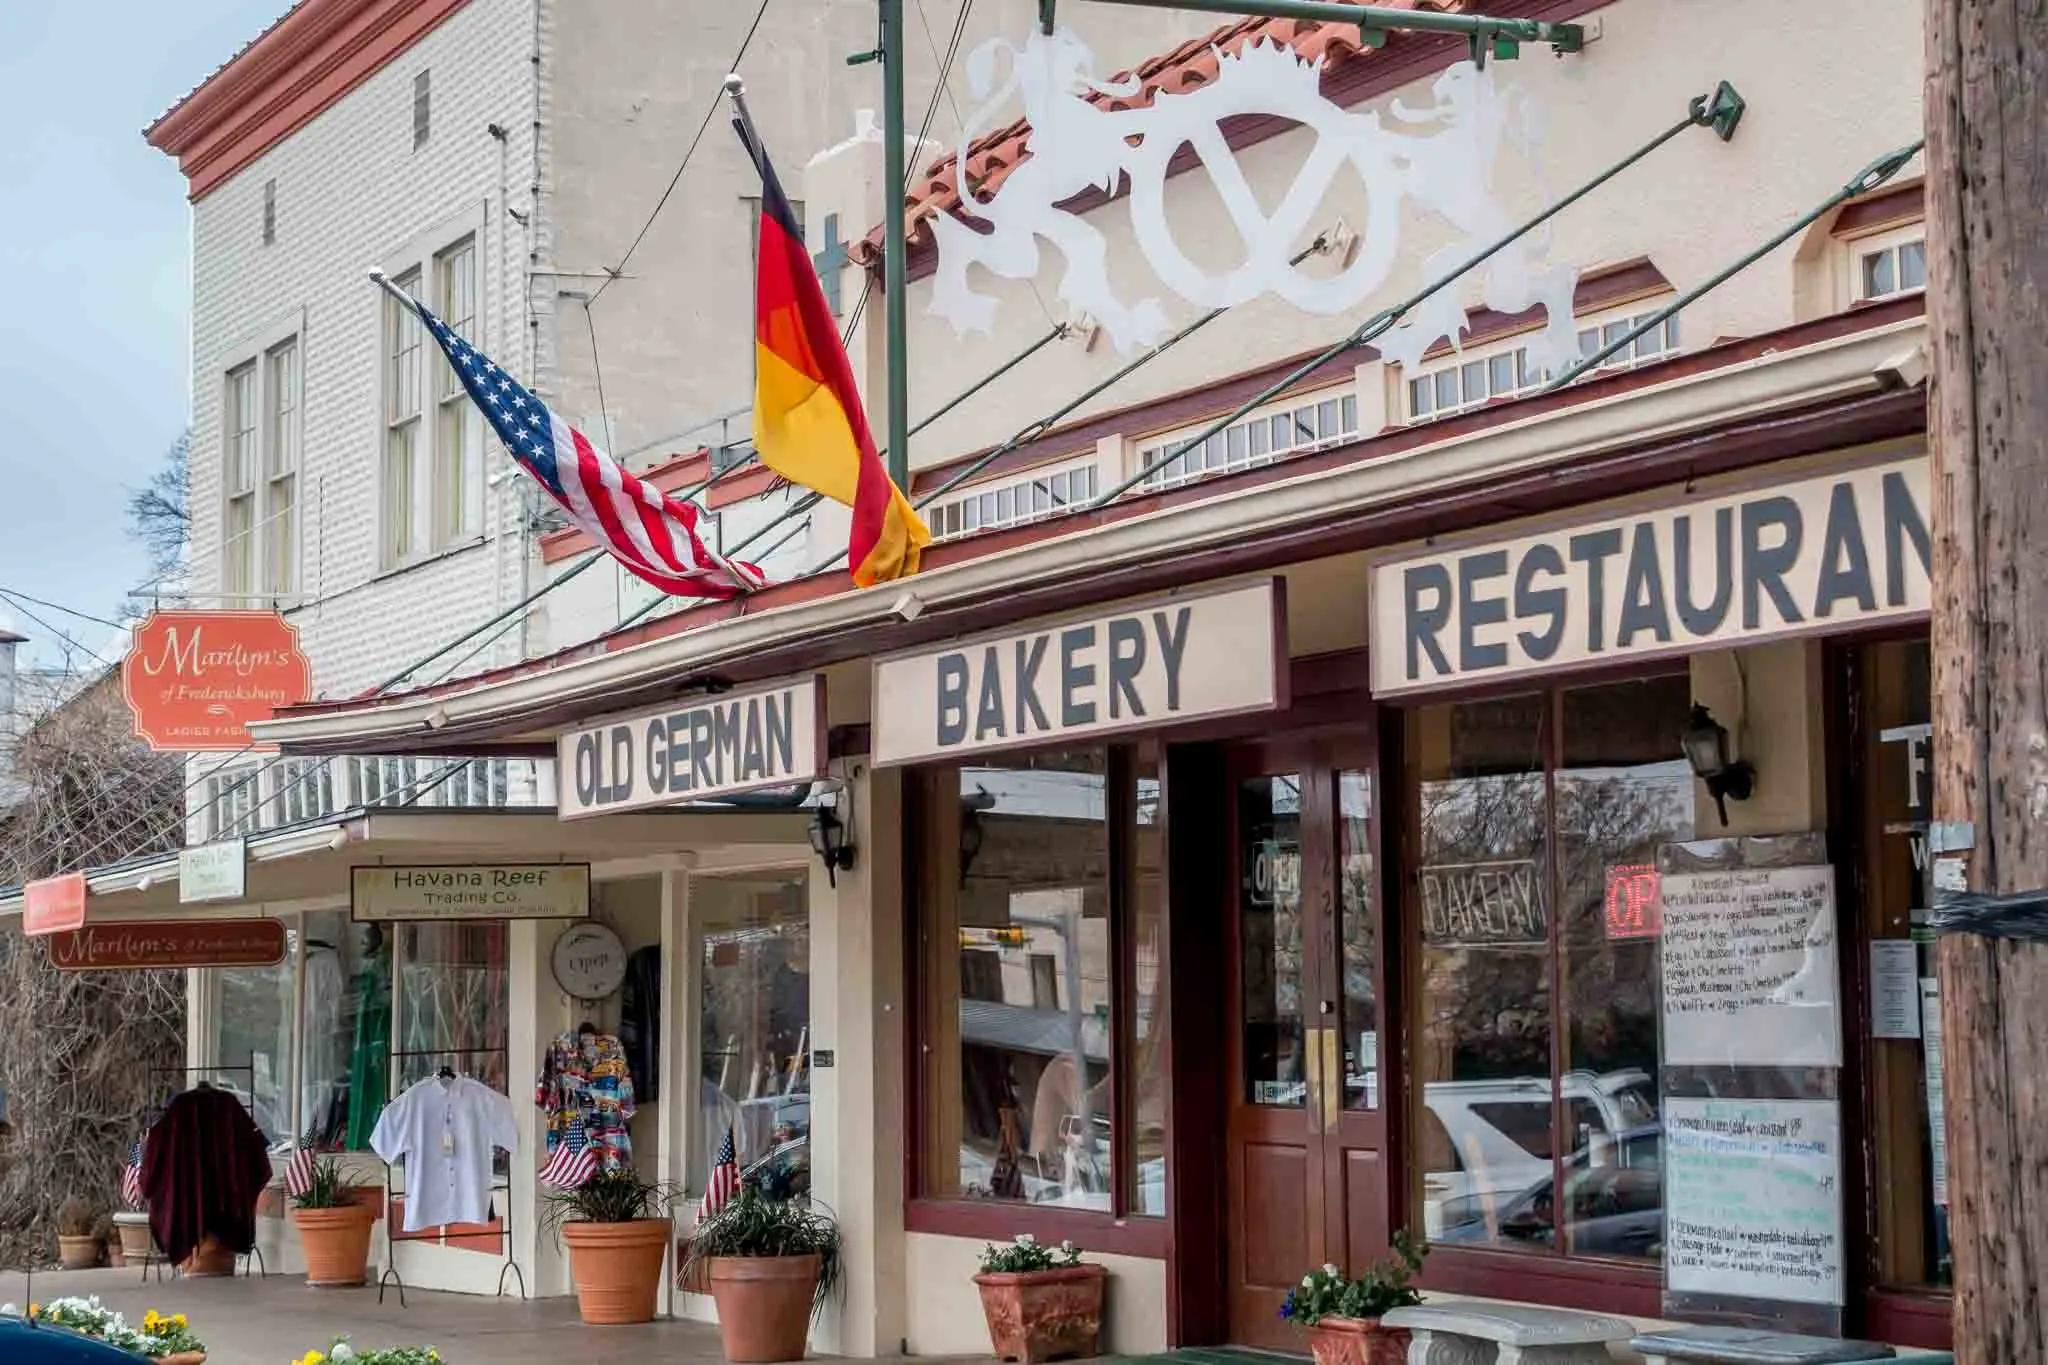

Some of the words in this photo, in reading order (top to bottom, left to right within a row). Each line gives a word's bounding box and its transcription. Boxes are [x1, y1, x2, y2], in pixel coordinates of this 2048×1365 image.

[1404, 472, 1931, 681] RESTAURAN
[143, 625, 289, 677] Marilyn's
[937, 606, 1191, 746] BAKERY
[177, 684, 286, 706] Fredericksburg
[166, 727, 210, 736] LADIES
[215, 727, 250, 736] FASH
[575, 725, 634, 807] OLD
[646, 690, 792, 794] GERMAN
[393, 871, 482, 888] Havana
[489, 869, 551, 887] Reef
[423, 892, 487, 904] Trading
[492, 891, 521, 904] Co.
[1423, 868, 1536, 936] BAKERY
[1608, 874, 1661, 927] OP
